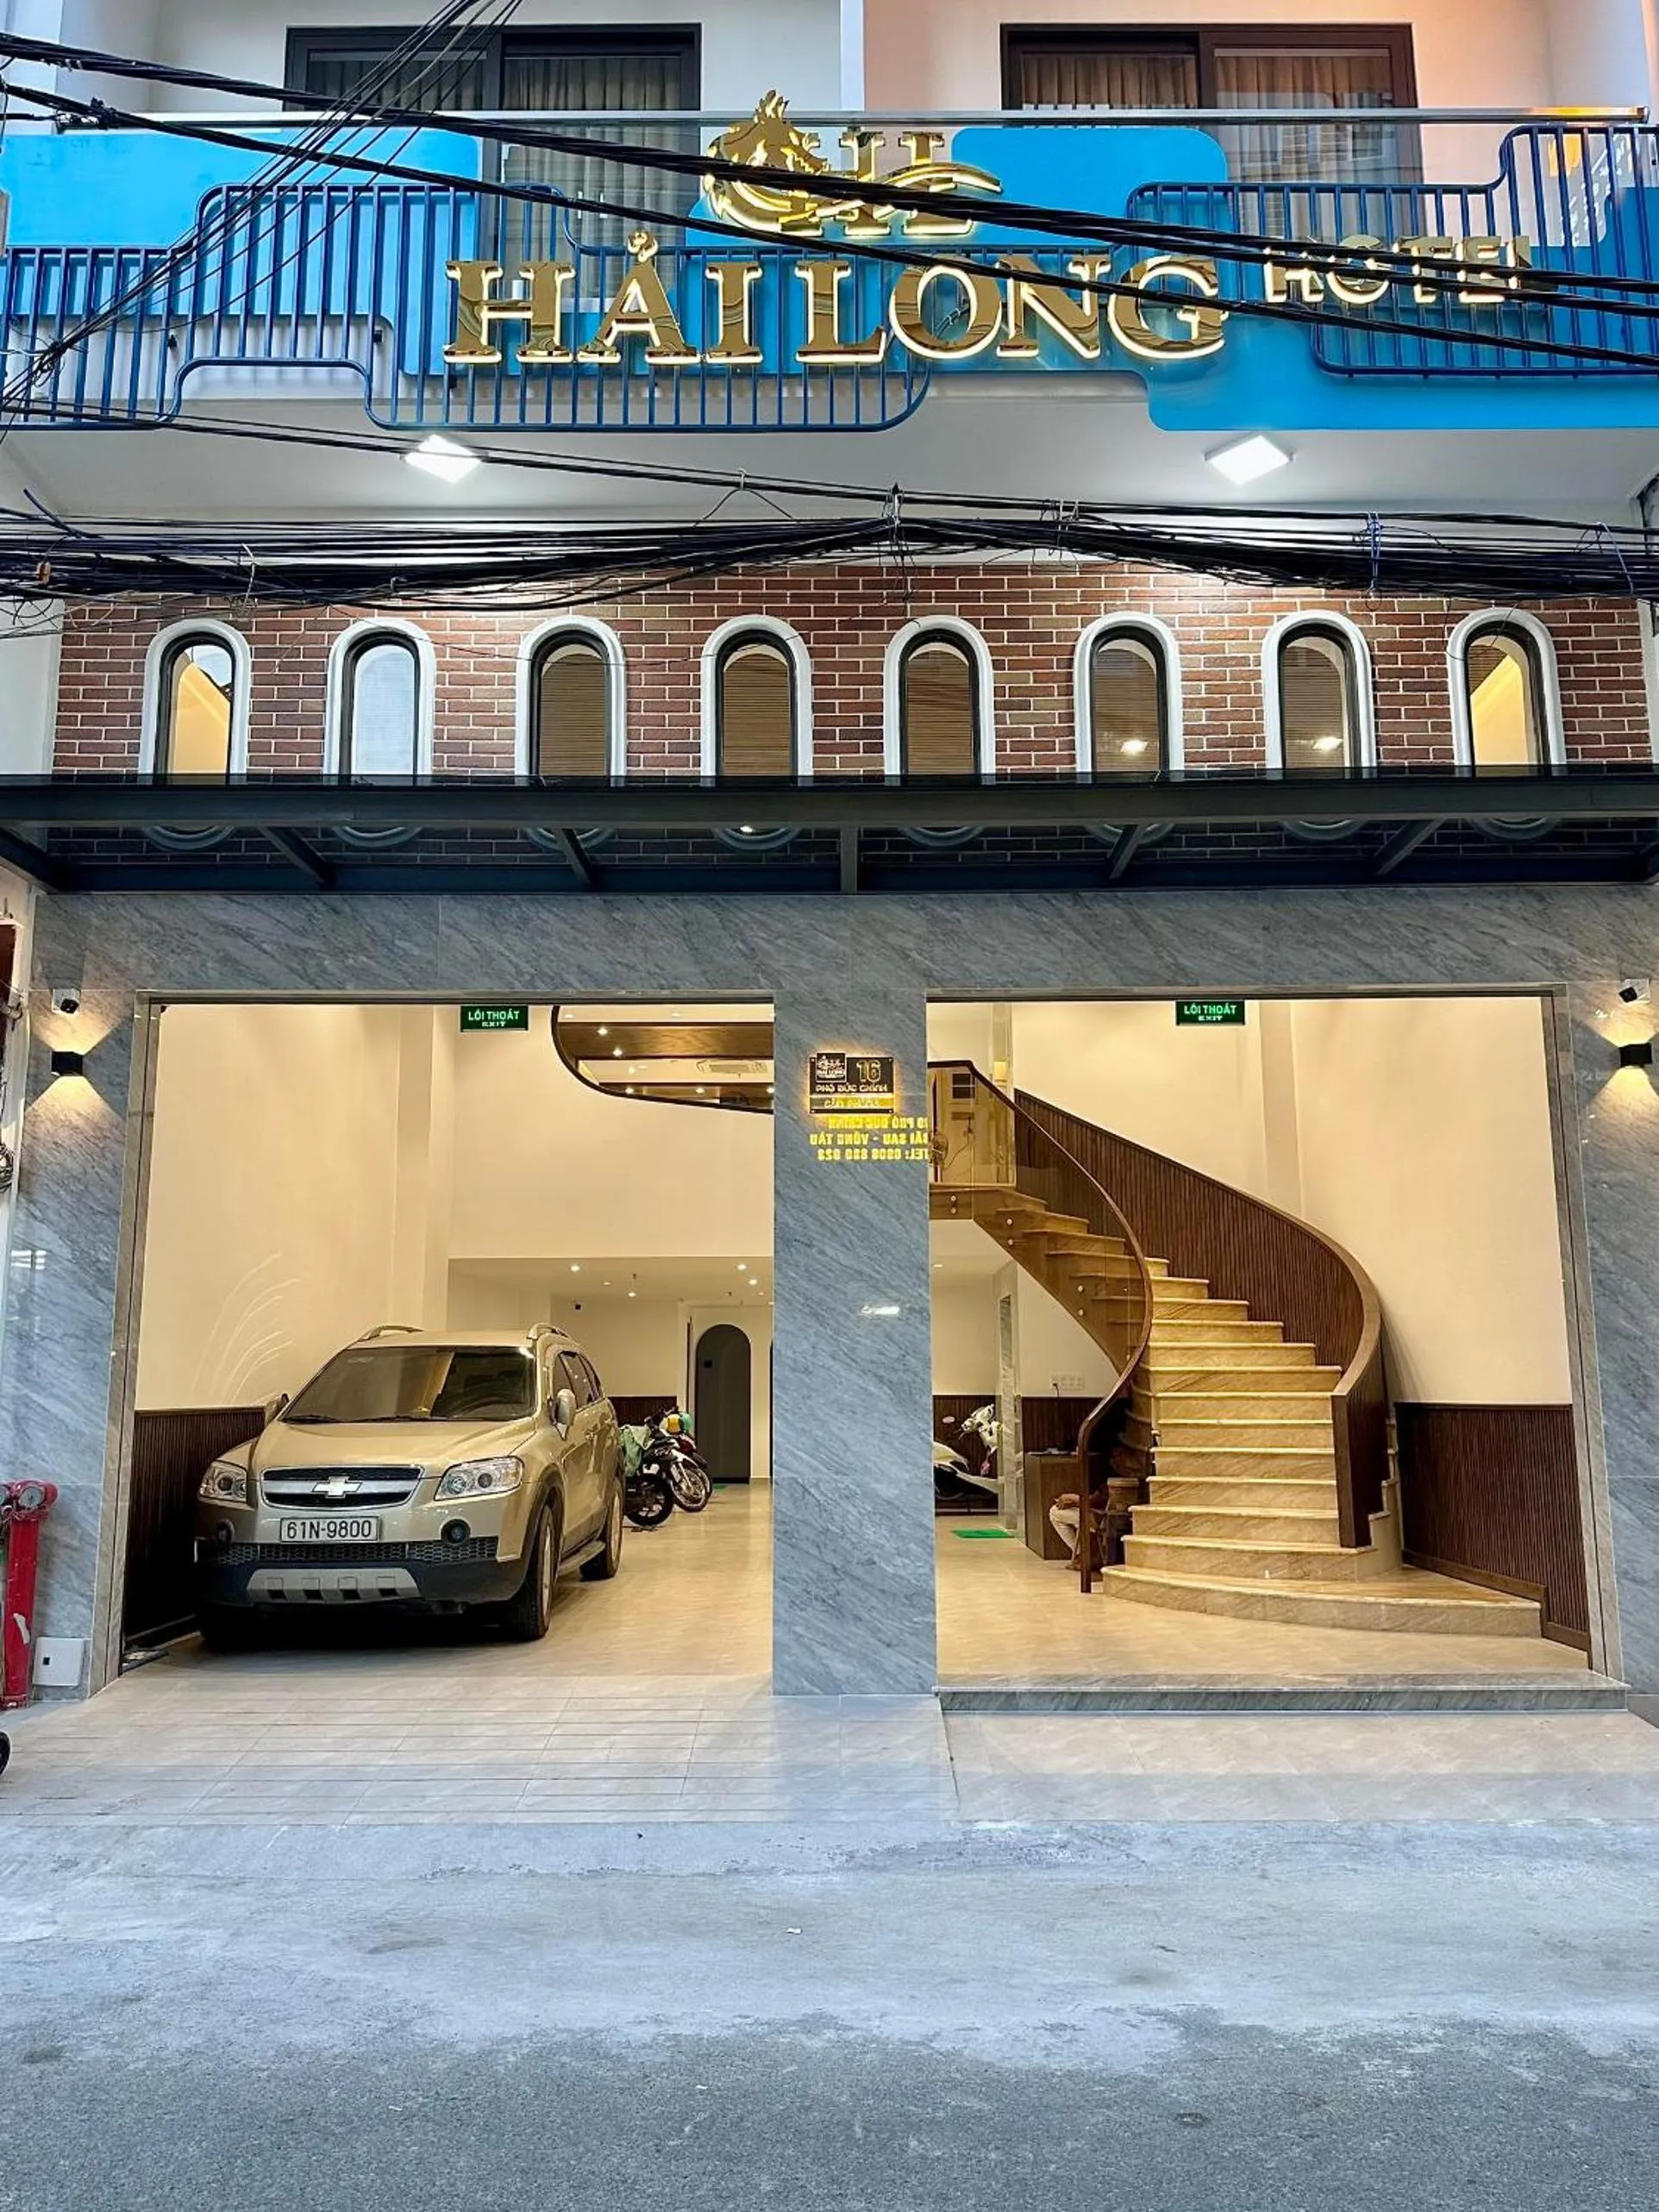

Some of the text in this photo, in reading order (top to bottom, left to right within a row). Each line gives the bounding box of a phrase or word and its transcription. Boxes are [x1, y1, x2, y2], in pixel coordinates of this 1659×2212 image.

[443, 229, 1557, 364] HẢI LONG HOTEL
[486, 1008, 520, 1020] THOÁT
[1203, 1002, 1236, 1014] THOÁT
[856, 1060, 881, 1083] 16
[286, 1520, 372, 1539] 61N-9800
